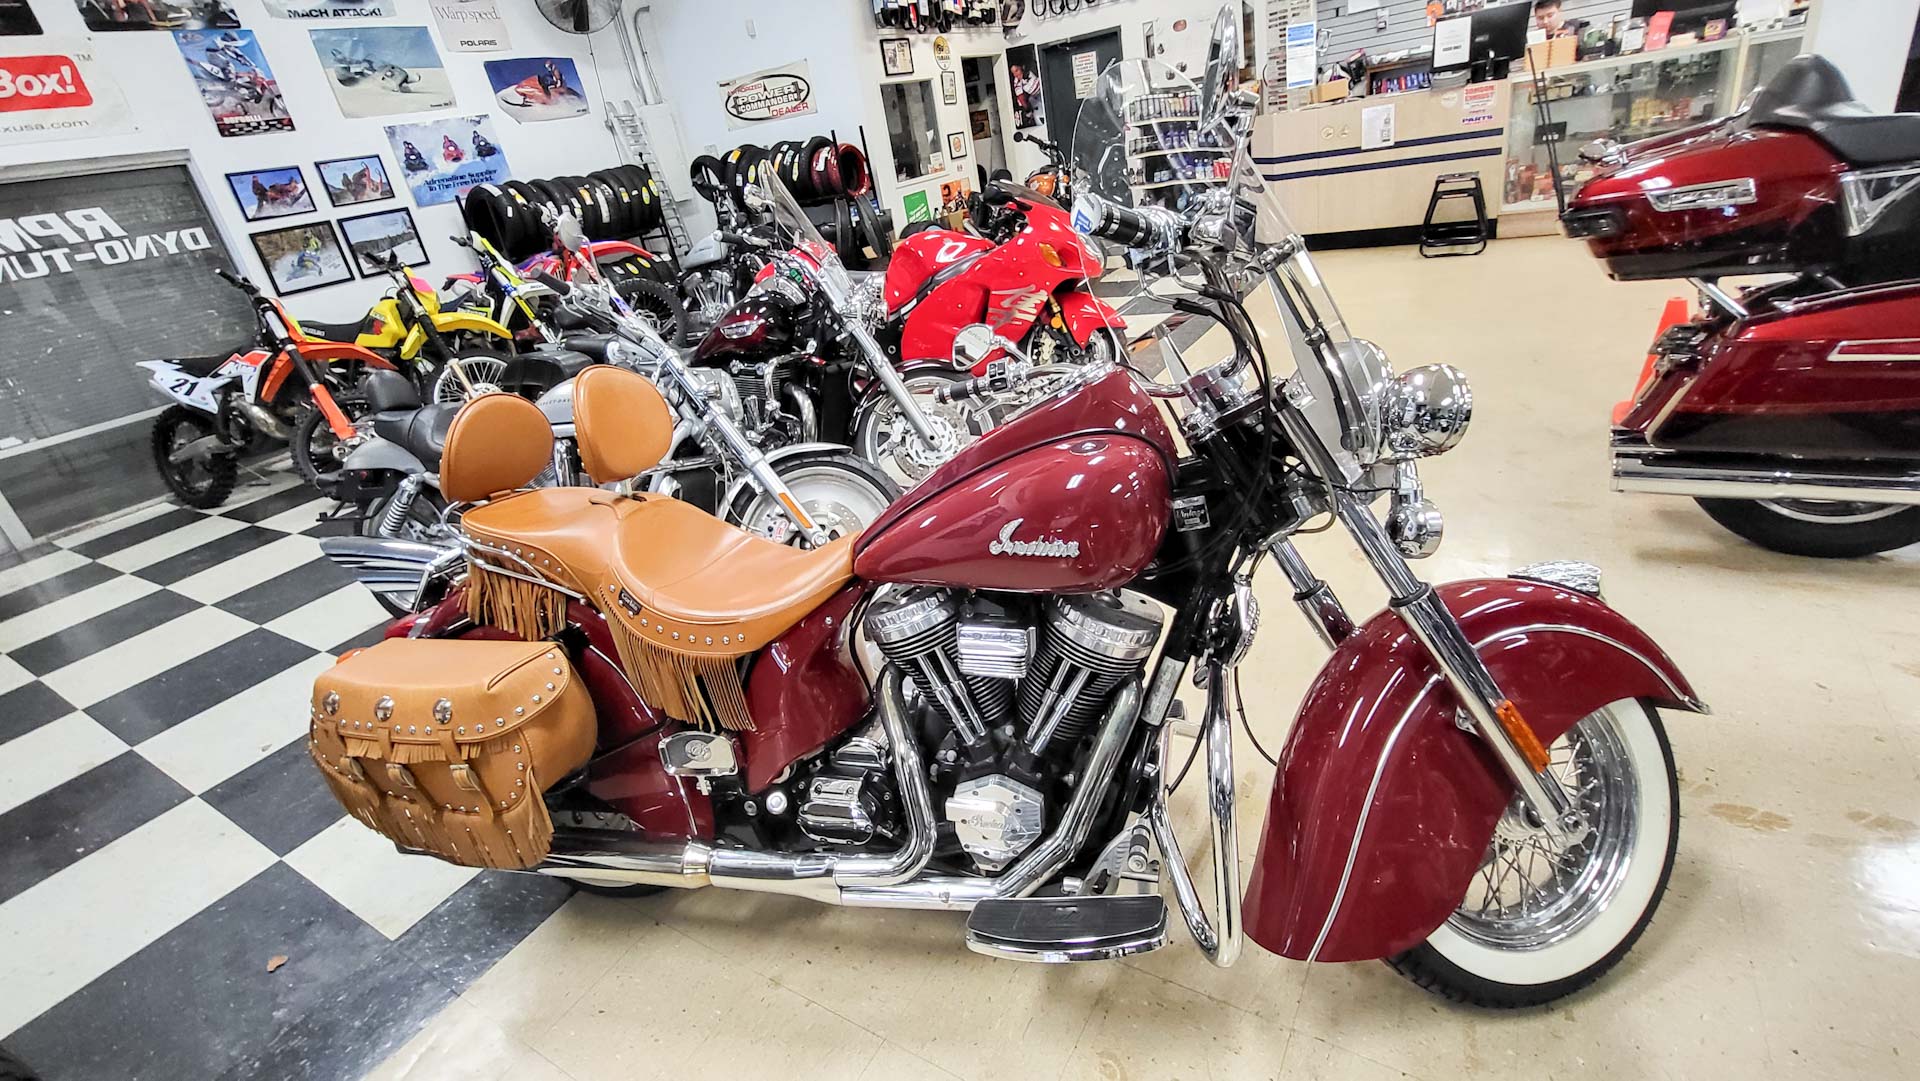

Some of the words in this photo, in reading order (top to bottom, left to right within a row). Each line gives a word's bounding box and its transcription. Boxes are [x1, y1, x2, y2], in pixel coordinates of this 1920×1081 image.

[288, 9, 328, 18] MACH
[333, 8, 382, 17] ATTACK!
[738, 85, 796, 105] POWER
[771, 102, 809, 117] DEALER
[424, 174, 467, 186] Adrenaline
[468, 169, 498, 178] Supplier
[471, 176, 494, 184] World.
[169, 378, 200, 396] 21
